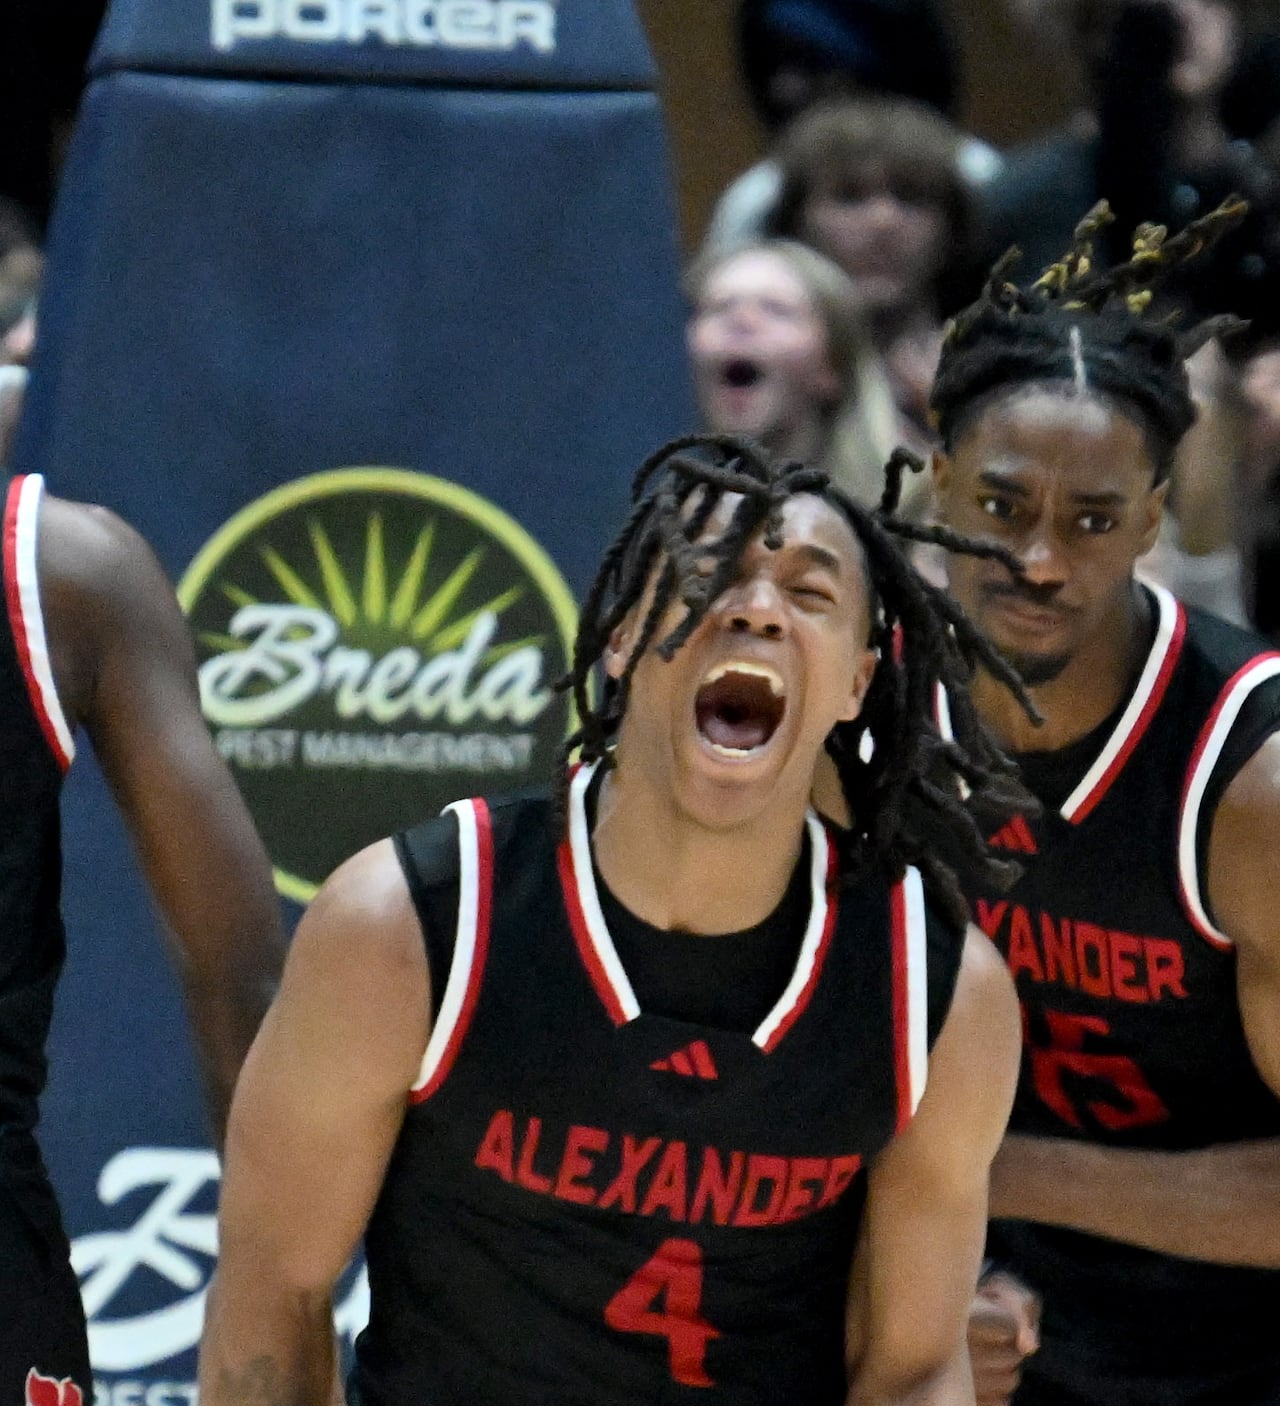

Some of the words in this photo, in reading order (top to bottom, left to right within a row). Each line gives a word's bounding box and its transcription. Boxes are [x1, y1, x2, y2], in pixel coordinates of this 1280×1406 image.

[197, 603, 555, 726] Breda
[302, 730, 533, 774] MANAGEMENT
[977, 897, 1190, 1004] XANDER
[604, 1237, 724, 1388] 4
